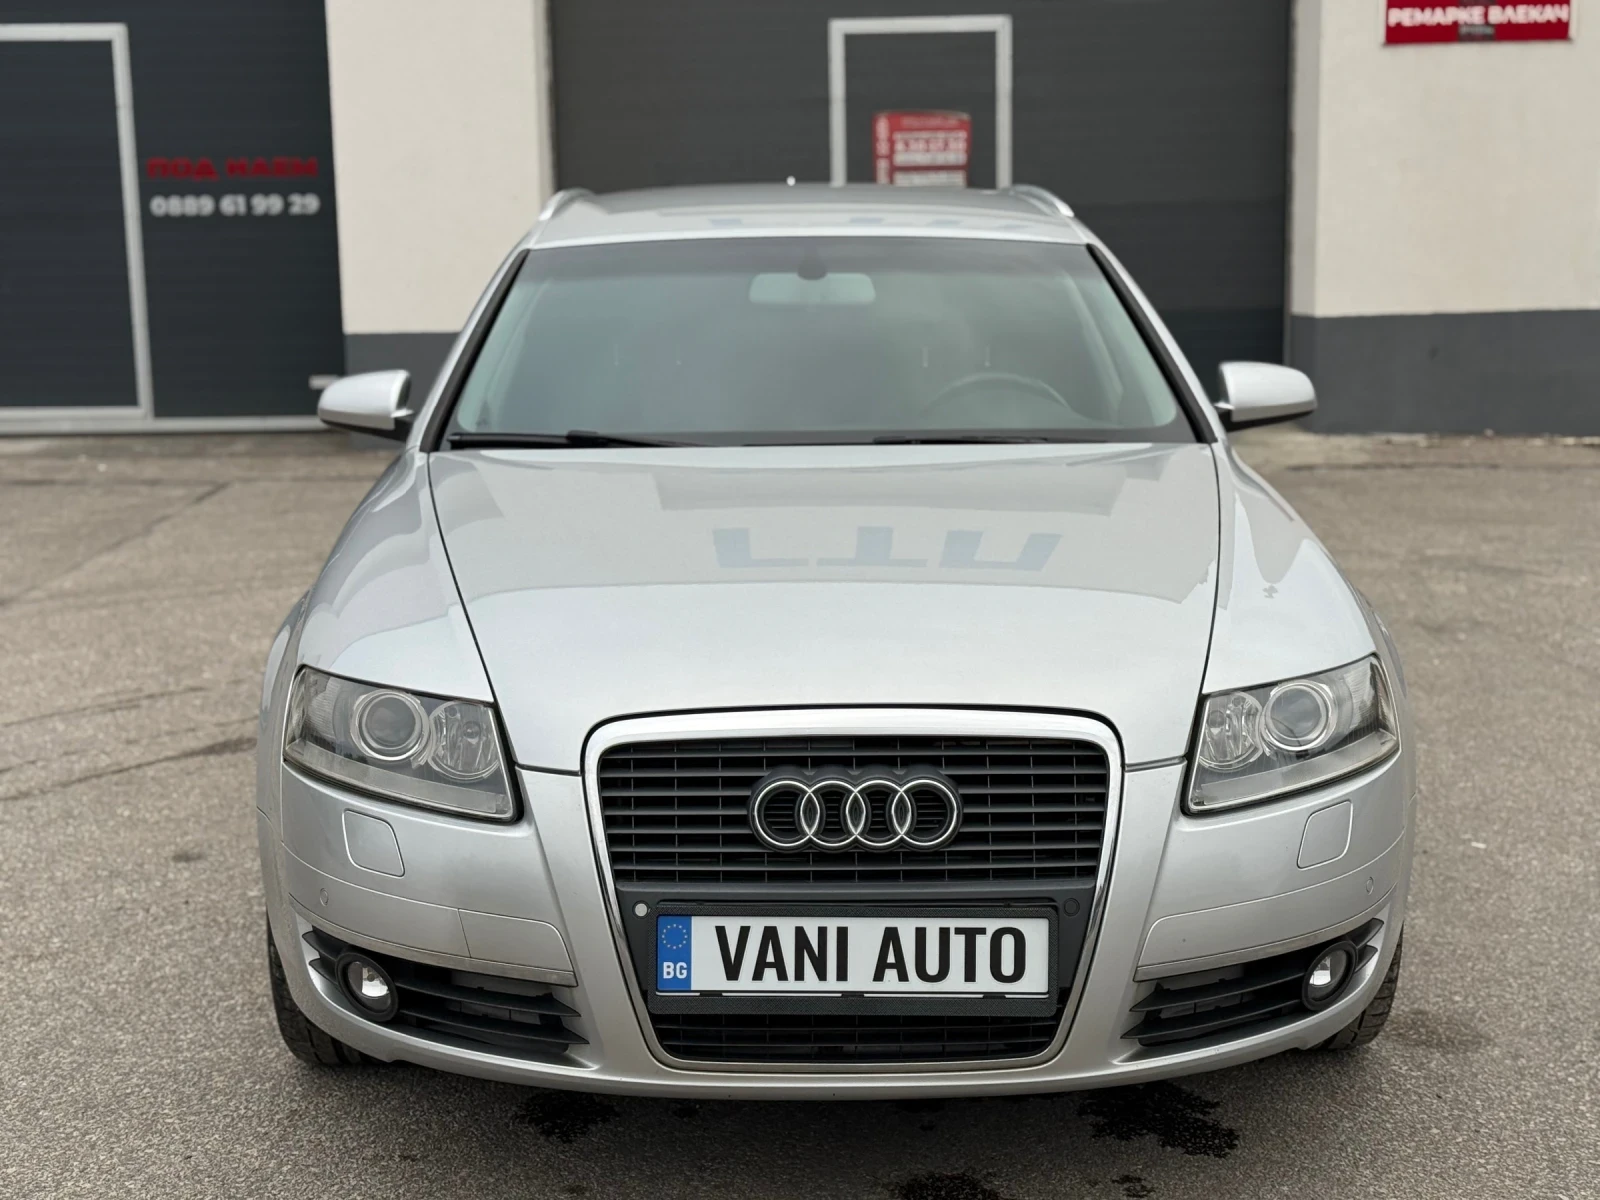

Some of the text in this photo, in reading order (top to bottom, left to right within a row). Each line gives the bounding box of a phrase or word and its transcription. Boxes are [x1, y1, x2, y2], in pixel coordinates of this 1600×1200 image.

[1387, 6, 1485, 27] РЕМАРКЕ
[146, 156, 319, 181] ПОД НАЕМ
[150, 192, 321, 217] 0889 61 99 29
[714, 925, 1027, 984] VANI AUTO
[662, 961, 688, 980] BG
